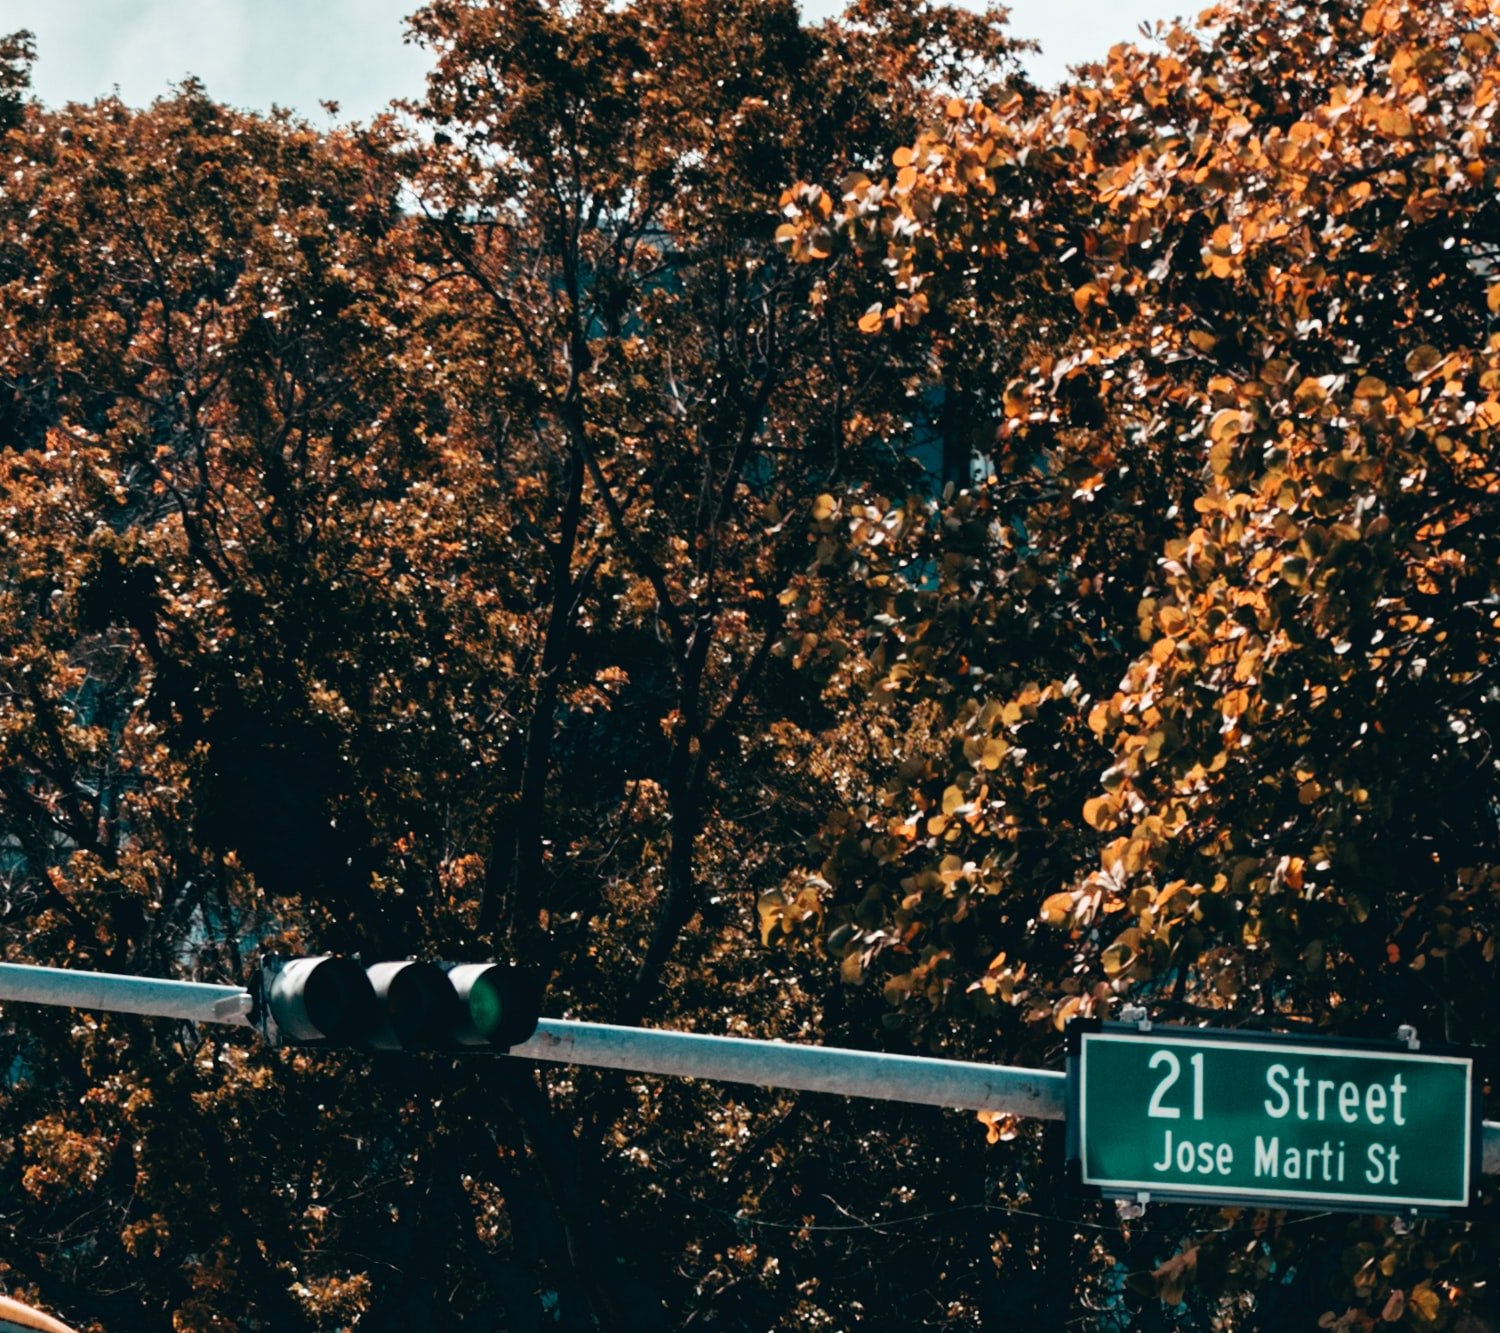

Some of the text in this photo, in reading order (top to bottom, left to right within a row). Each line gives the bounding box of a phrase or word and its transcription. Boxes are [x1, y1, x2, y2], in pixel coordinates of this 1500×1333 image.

[1147, 1049, 1408, 1127] 21 Street
[1152, 1129, 1401, 1186] Jose Marti St
